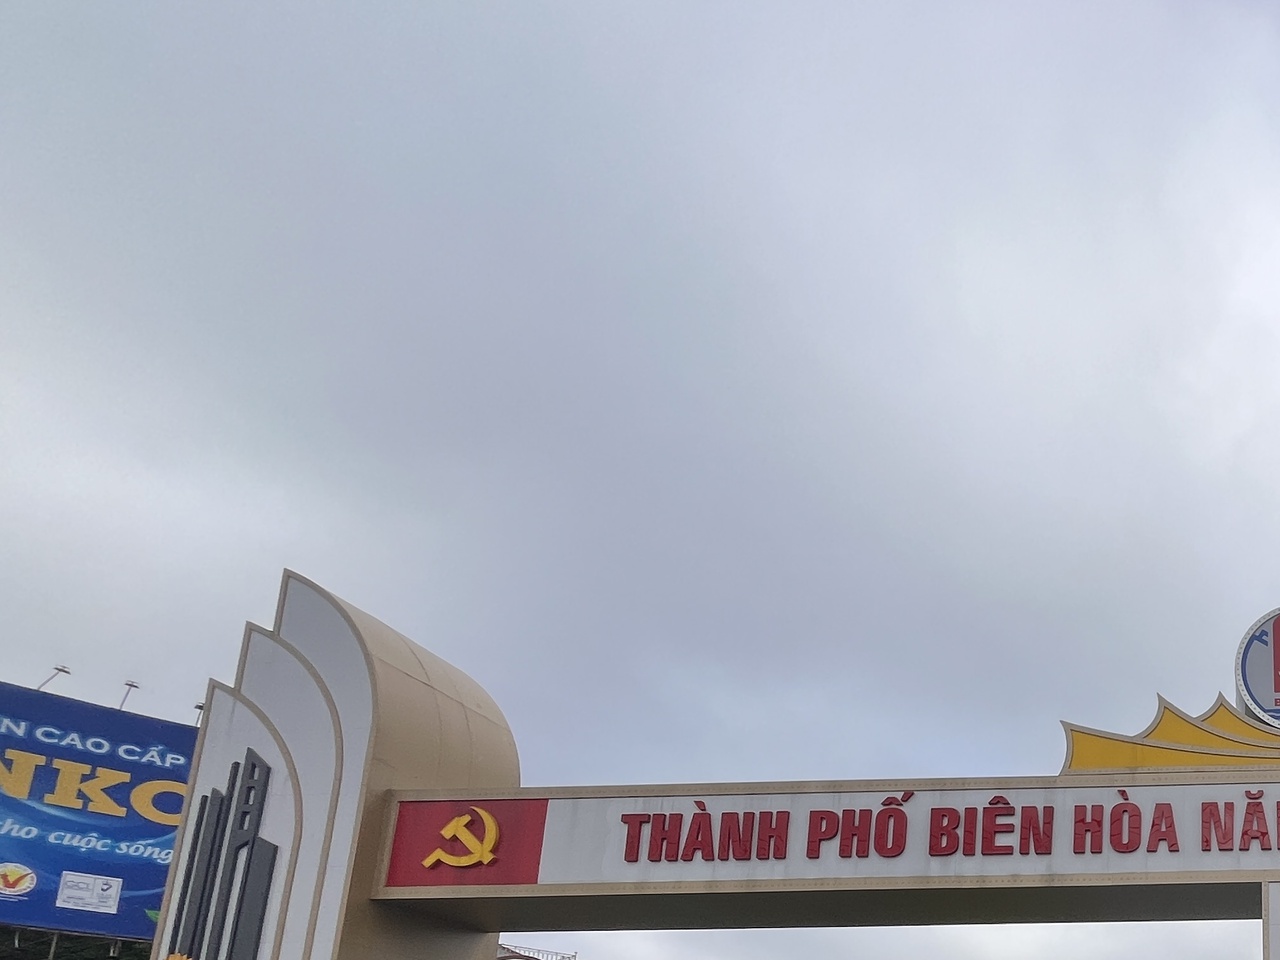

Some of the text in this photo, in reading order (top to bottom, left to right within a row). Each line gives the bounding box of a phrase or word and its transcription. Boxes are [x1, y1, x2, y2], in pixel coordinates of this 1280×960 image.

[35, 727, 110, 754] CAO
[118, 745, 186, 767] CẤP
[48, 832, 112, 852] cuộc
[621, 800, 790, 863] THÀNH
[806, 791, 915, 859] PHỐ
[929, 795, 1055, 857] BIÊN
[1073, 789, 1180, 854] HÒA
